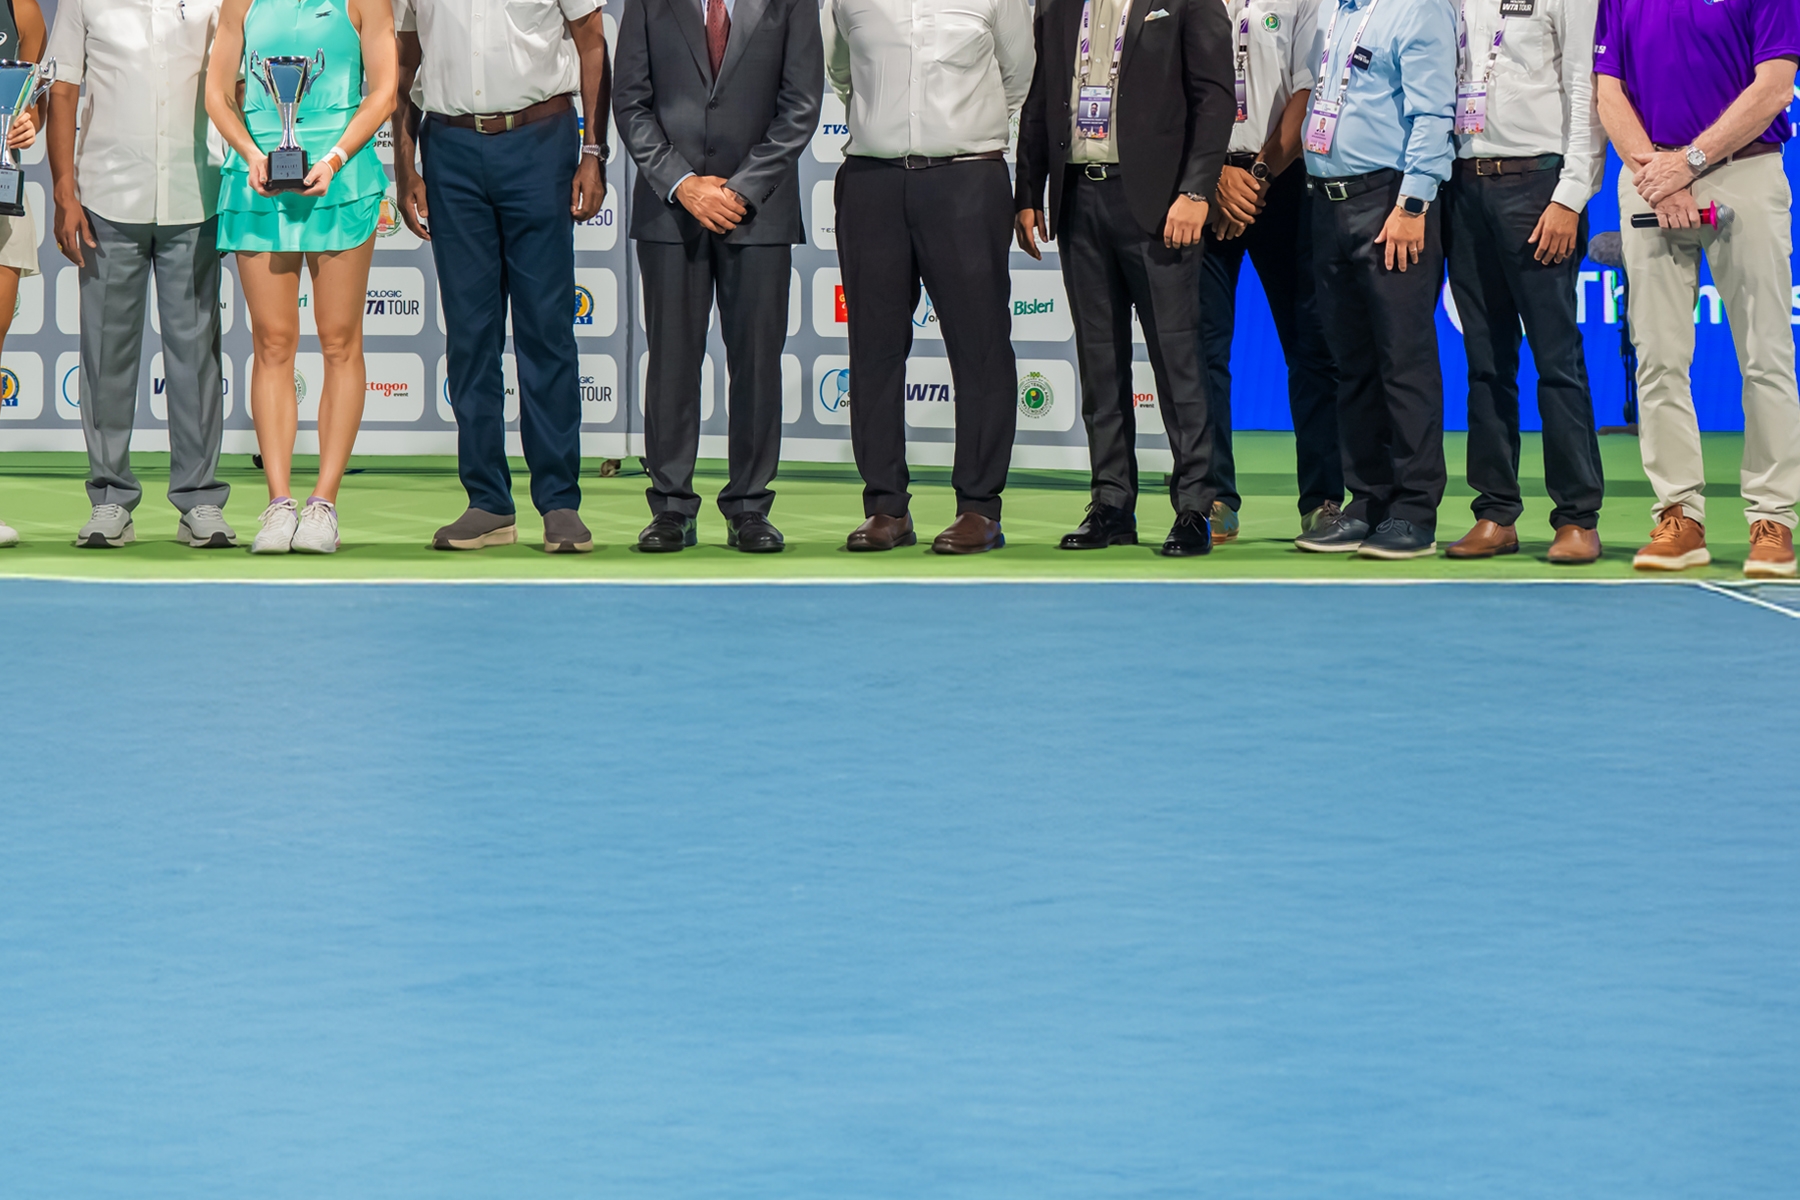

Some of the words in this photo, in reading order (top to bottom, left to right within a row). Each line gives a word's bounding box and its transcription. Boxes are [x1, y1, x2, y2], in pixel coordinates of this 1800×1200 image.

[366, 300, 385, 315] TA
[388, 300, 420, 315] TOUR
[1014, 298, 1054, 316] Bisleri
[366, 383, 408, 397] tagon
[580, 386, 612, 402] TOUR
[906, 384, 950, 402] WTA
